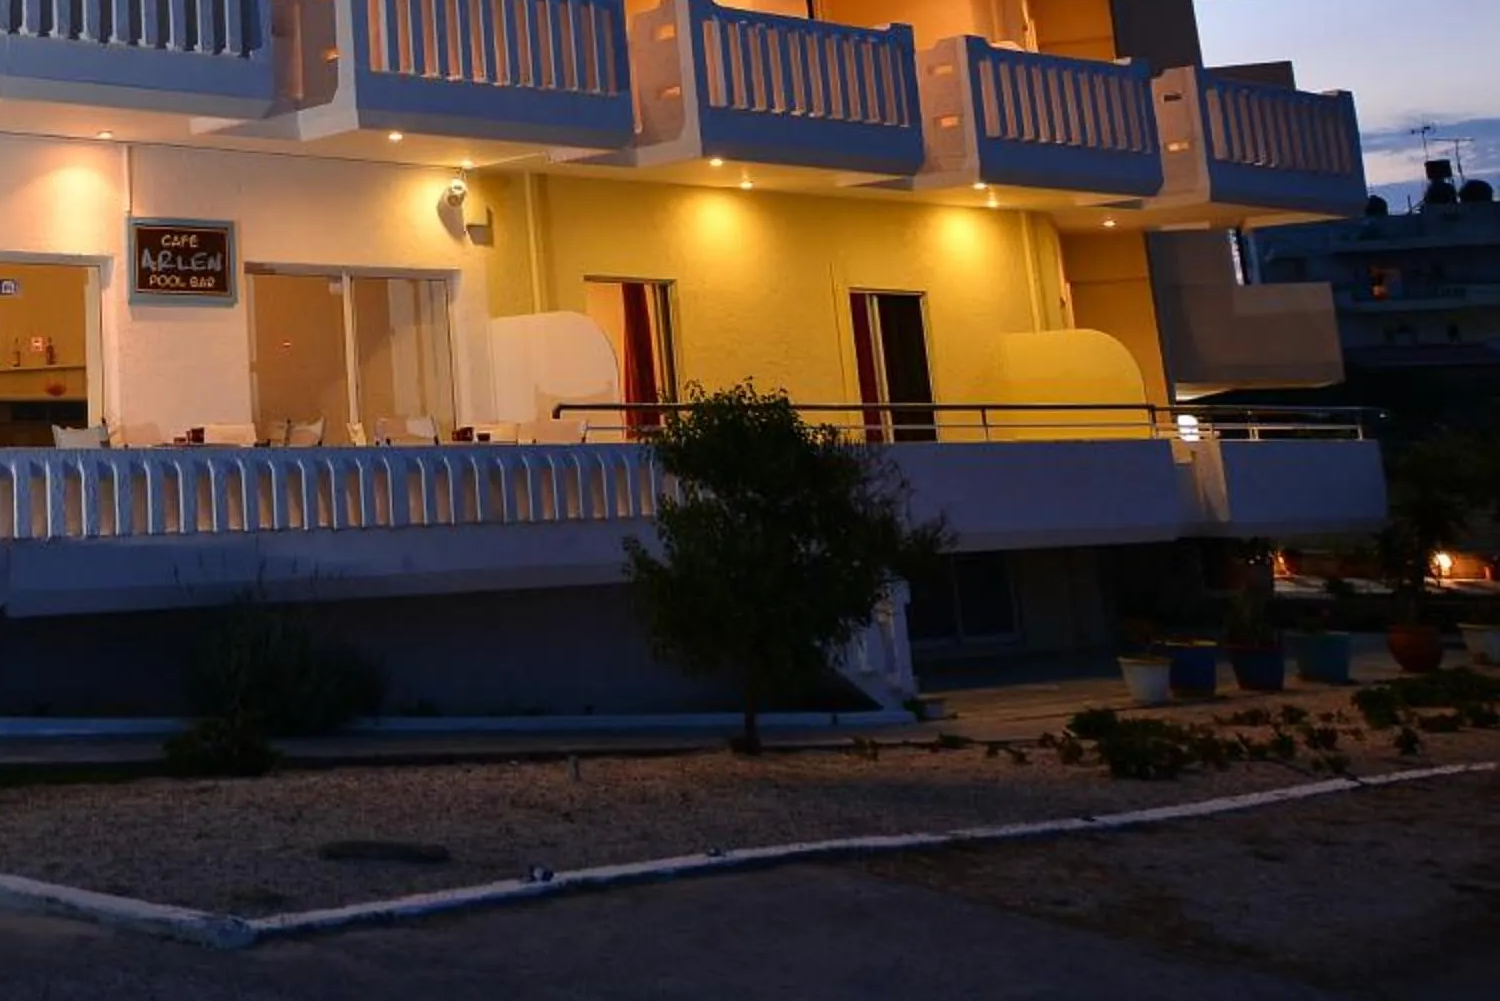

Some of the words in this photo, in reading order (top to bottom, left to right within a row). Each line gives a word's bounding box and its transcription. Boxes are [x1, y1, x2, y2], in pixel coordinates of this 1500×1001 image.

[141, 248, 222, 272] ARLEN
[149, 275, 186, 288] POOL
[189, 276, 216, 288] BAR
